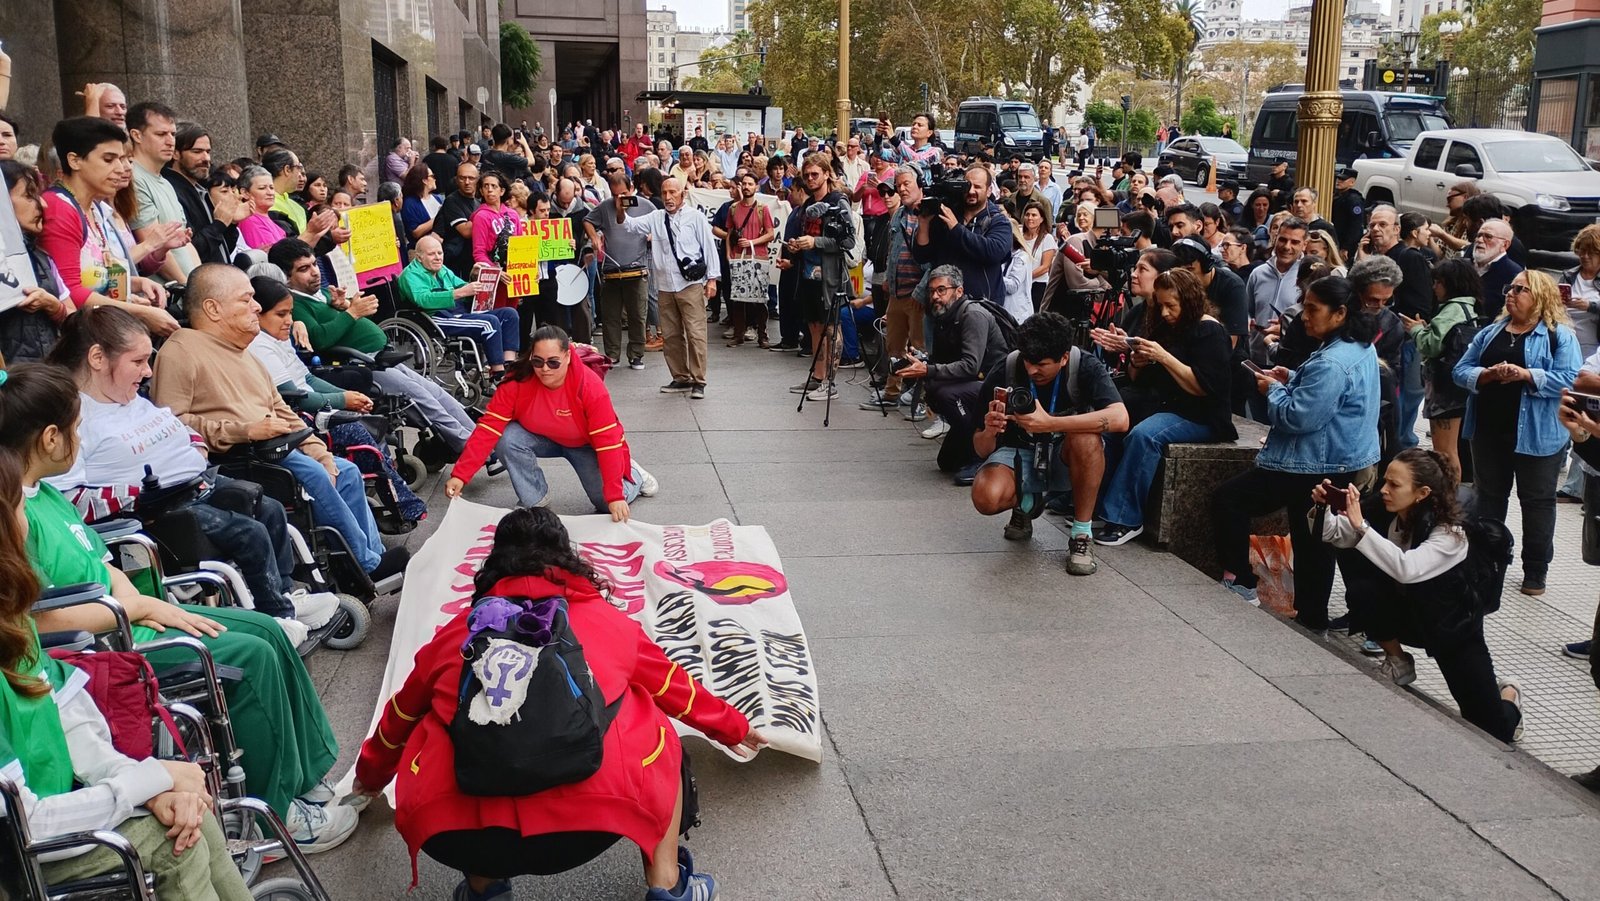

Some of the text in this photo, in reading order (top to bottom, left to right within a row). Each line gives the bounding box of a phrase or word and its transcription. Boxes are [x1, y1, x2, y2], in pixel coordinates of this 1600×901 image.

[513, 274, 530, 296] NO
[131, 420, 181, 455] INCLUSIVO
[654, 589, 698, 644] PARAR
[707, 618, 761, 702] TAMPOCO
[765, 672, 816, 735] PODEMOS
